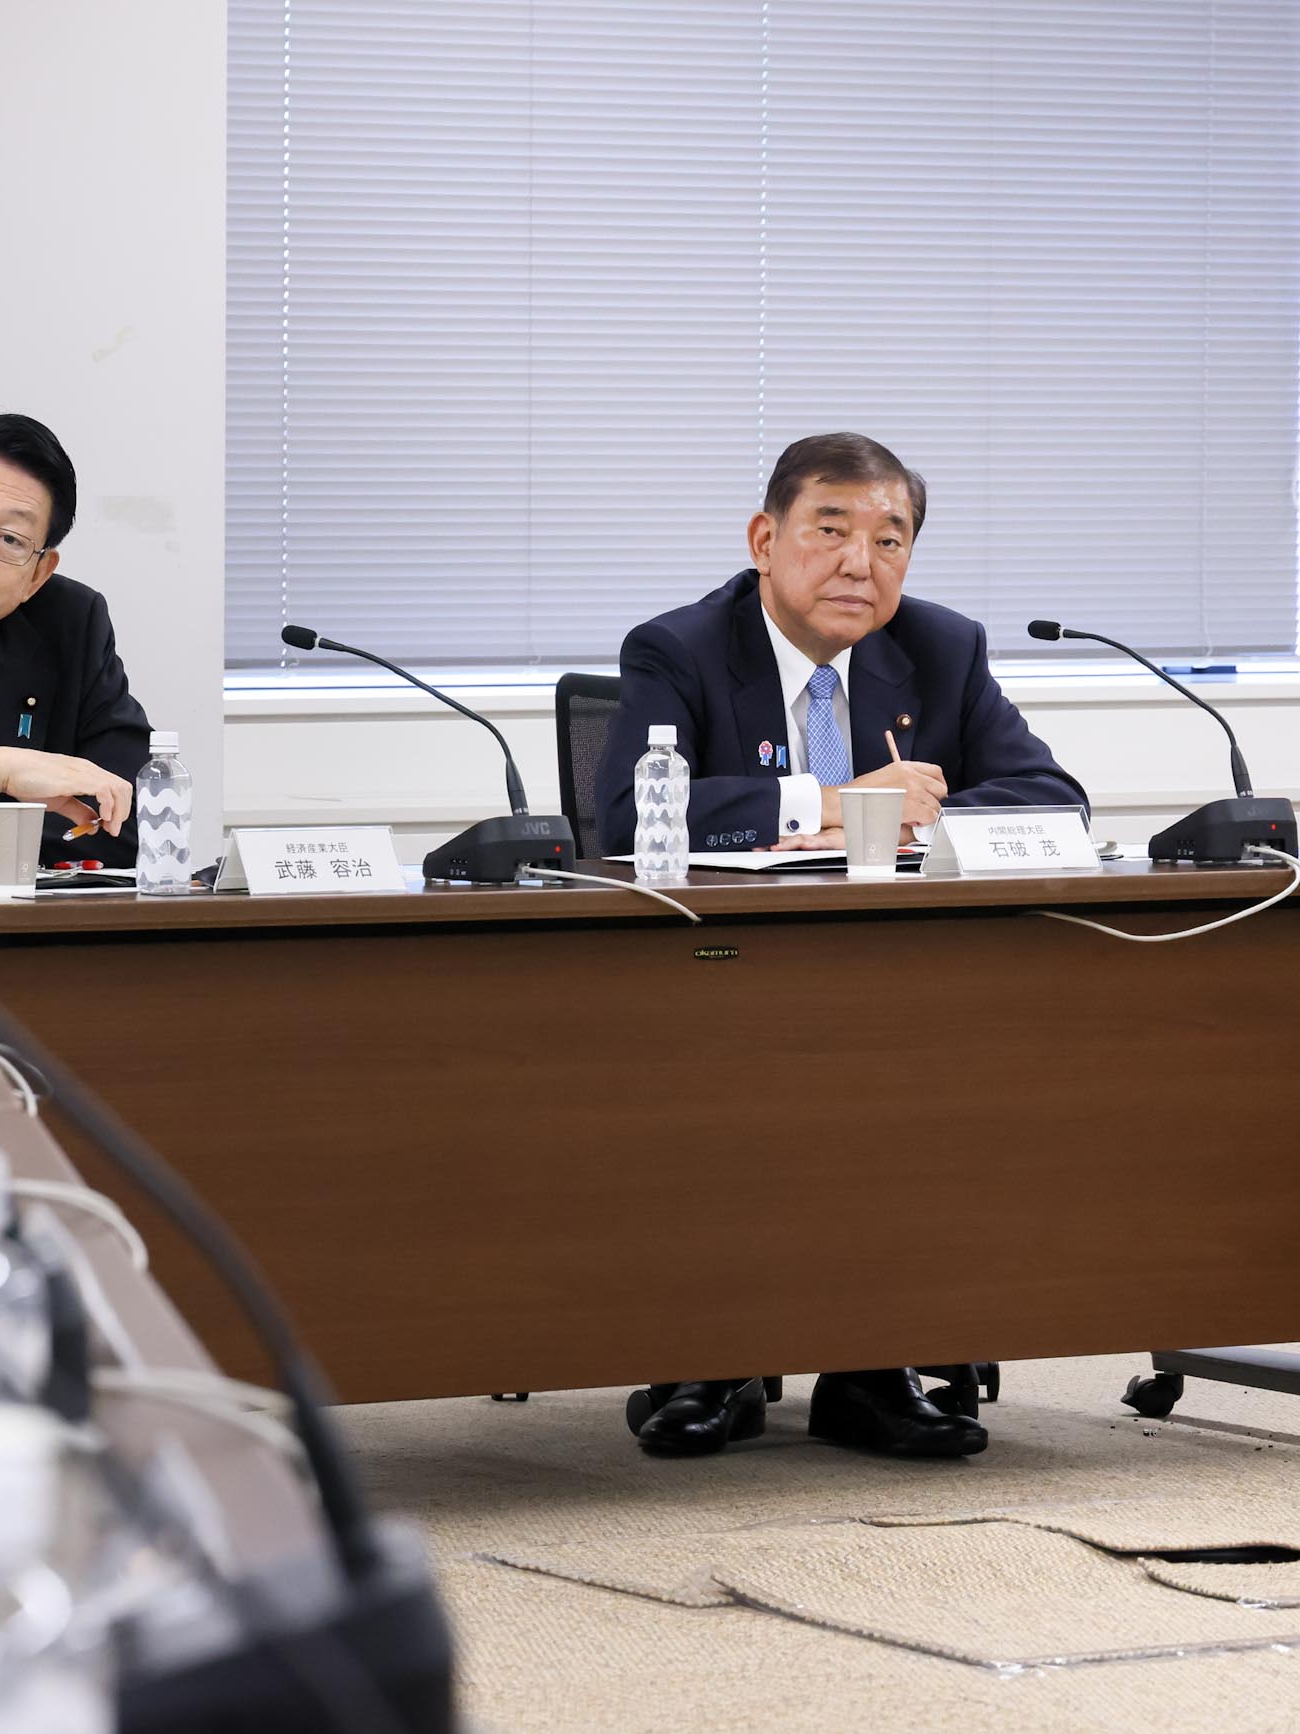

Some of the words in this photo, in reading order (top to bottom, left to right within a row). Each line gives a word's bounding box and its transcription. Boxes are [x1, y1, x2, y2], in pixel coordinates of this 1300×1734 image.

[523, 822, 550, 835] JVC
[285, 842, 349, 854] 経済産業大臣
[988, 840, 1030, 858] 石破
[1038, 839, 1061, 857] 茂
[274, 859, 318, 880] 武藤
[329, 857, 373, 879] 容治
